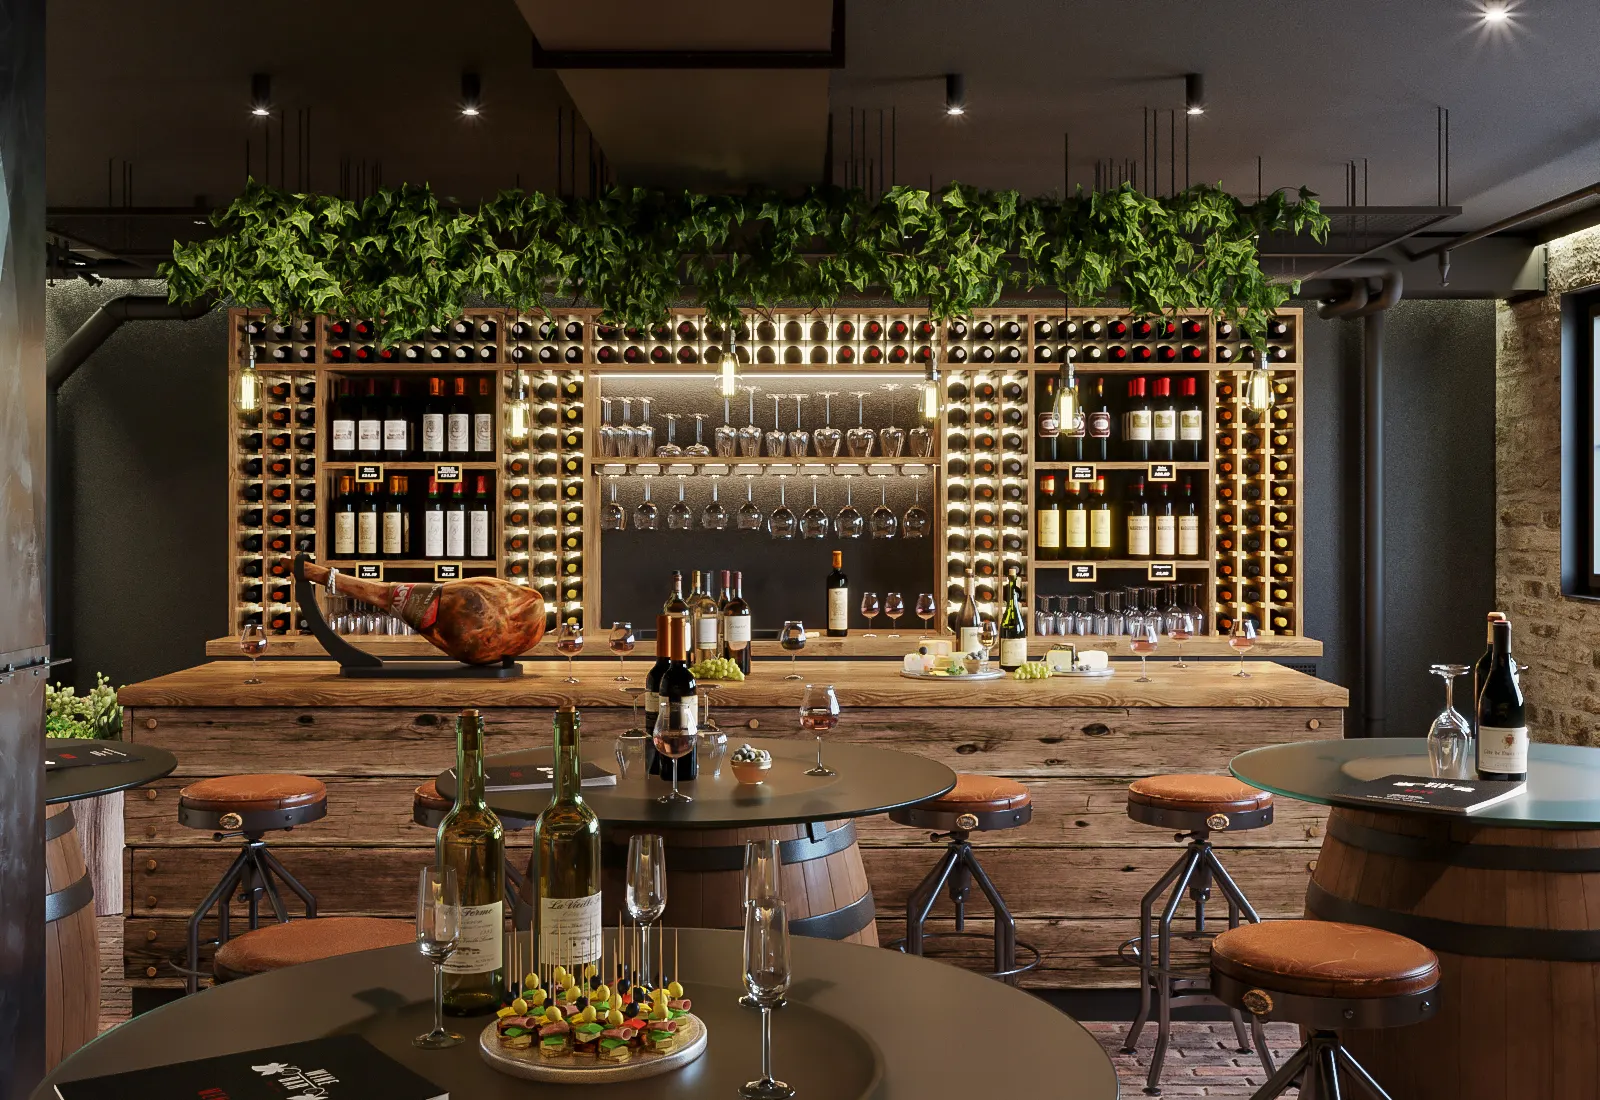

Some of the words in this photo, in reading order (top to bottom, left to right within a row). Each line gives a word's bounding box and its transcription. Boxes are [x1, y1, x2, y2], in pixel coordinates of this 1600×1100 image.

[547, 899, 564, 910] La
[461, 906, 494, 917] Ferme
[277, 1075, 309, 1090] BAR
[304, 1068, 340, 1086] WINE
